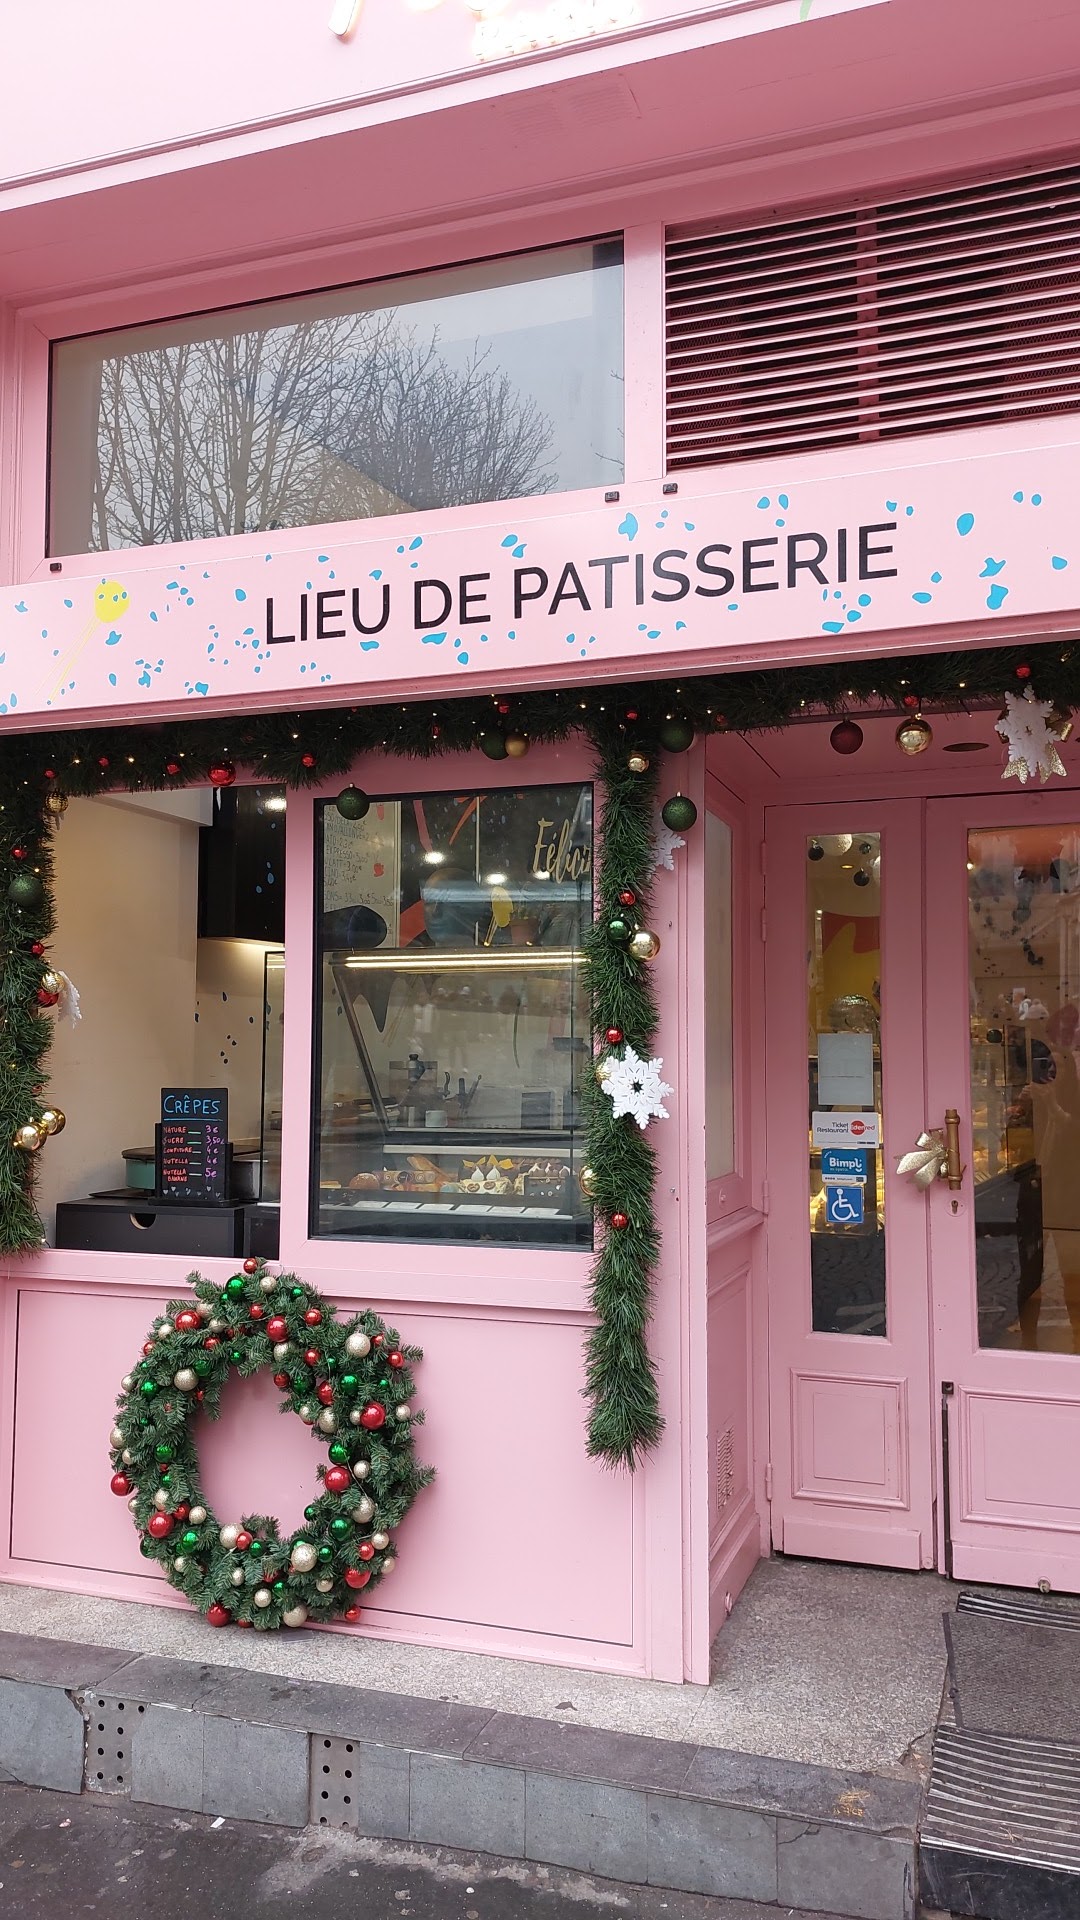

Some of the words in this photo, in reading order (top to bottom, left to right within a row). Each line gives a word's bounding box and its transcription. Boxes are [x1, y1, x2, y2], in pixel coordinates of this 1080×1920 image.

[265, 584, 391, 646] LIEU
[413, 573, 492, 629] DE
[513, 521, 899, 620] PATISSERIE
[163, 1095, 221, 1114] CRÊPES
